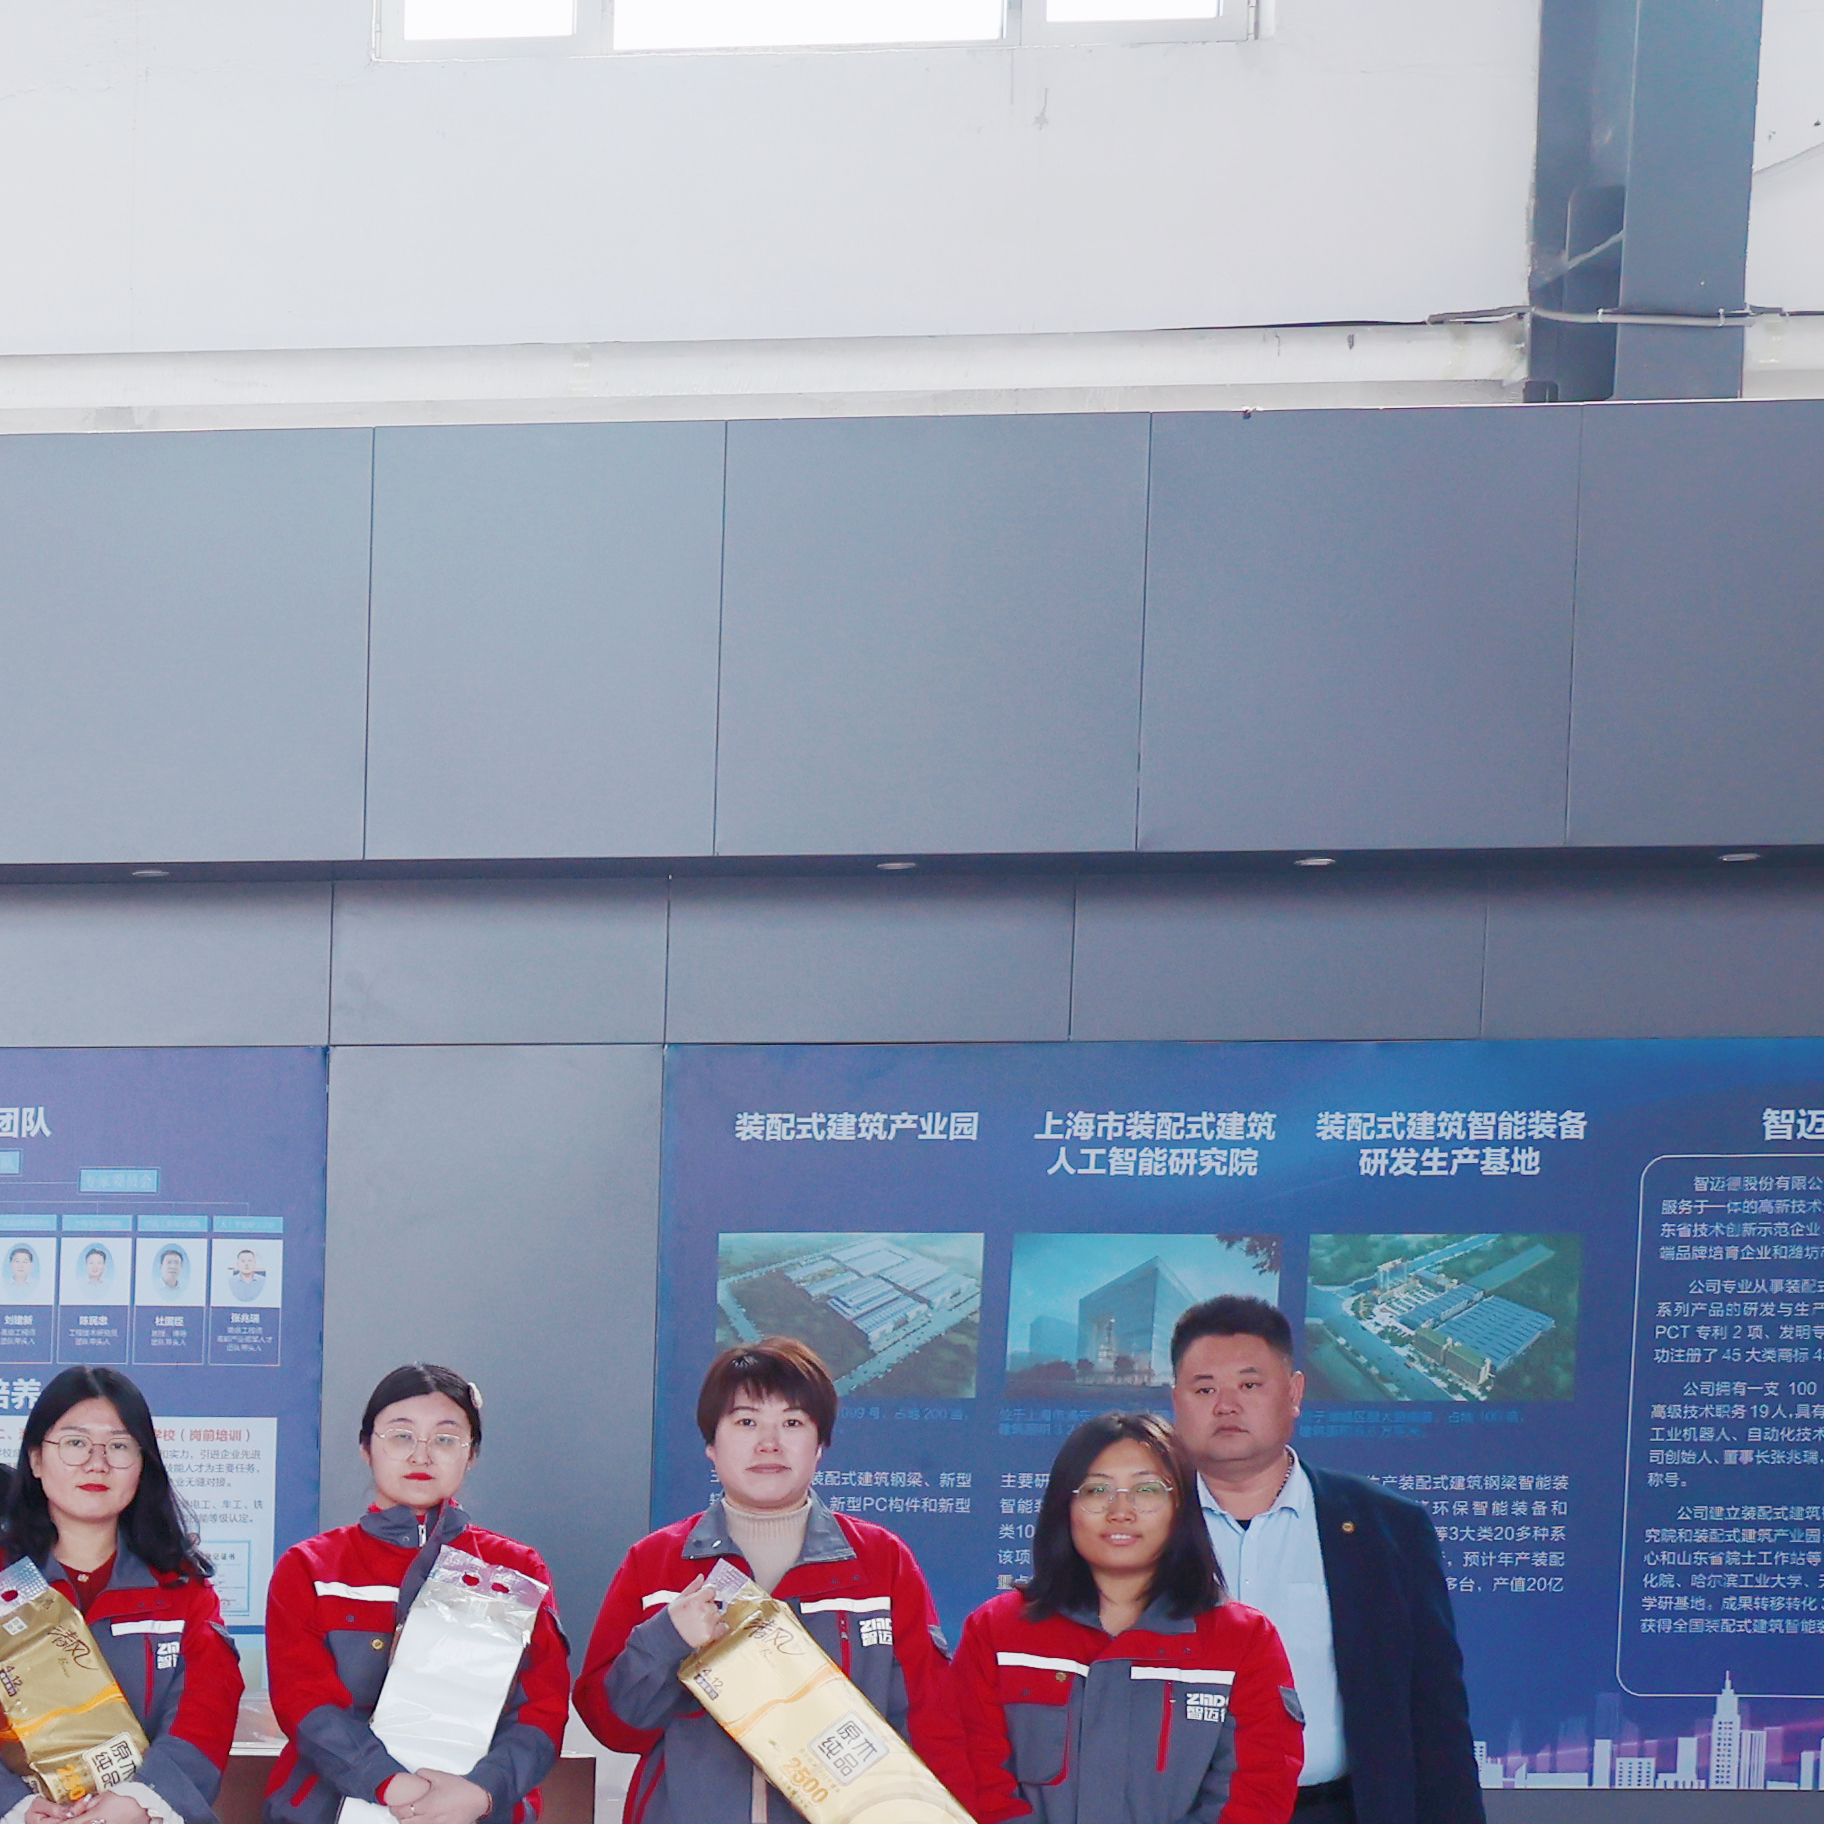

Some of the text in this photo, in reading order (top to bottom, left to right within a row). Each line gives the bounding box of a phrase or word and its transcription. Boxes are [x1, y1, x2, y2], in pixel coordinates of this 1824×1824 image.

[735, 1110, 979, 1143] 装配式建筑产业园
[1033, 1110, 1276, 1142] 上海市装配式建筑
[1316, 1110, 1587, 1142] 装配式建筑智能装备
[1047, 1147, 1257, 1177] 人工智能研究院
[1359, 1146, 1540, 1178] 研发生产基地
[1654, 1325, 1690, 1339] PCT
[1695, 1325, 1728, 1340] 专利
[1732, 1326, 1742, 1339] 2
[1653, 1348, 1809, 1363] 功注册了 45 大类商标
[1683, 1381, 1817, 1397] 公司拥有一支 100
[1647, 1472, 1687, 1488] 称号。
[829, 1496, 971, 1513] 新型PC构件和新型
[998, 1549, 1031, 1565] 该项
[818, 1736, 860, 1778] 纯品
[834, 1720, 880, 1764] 原木
